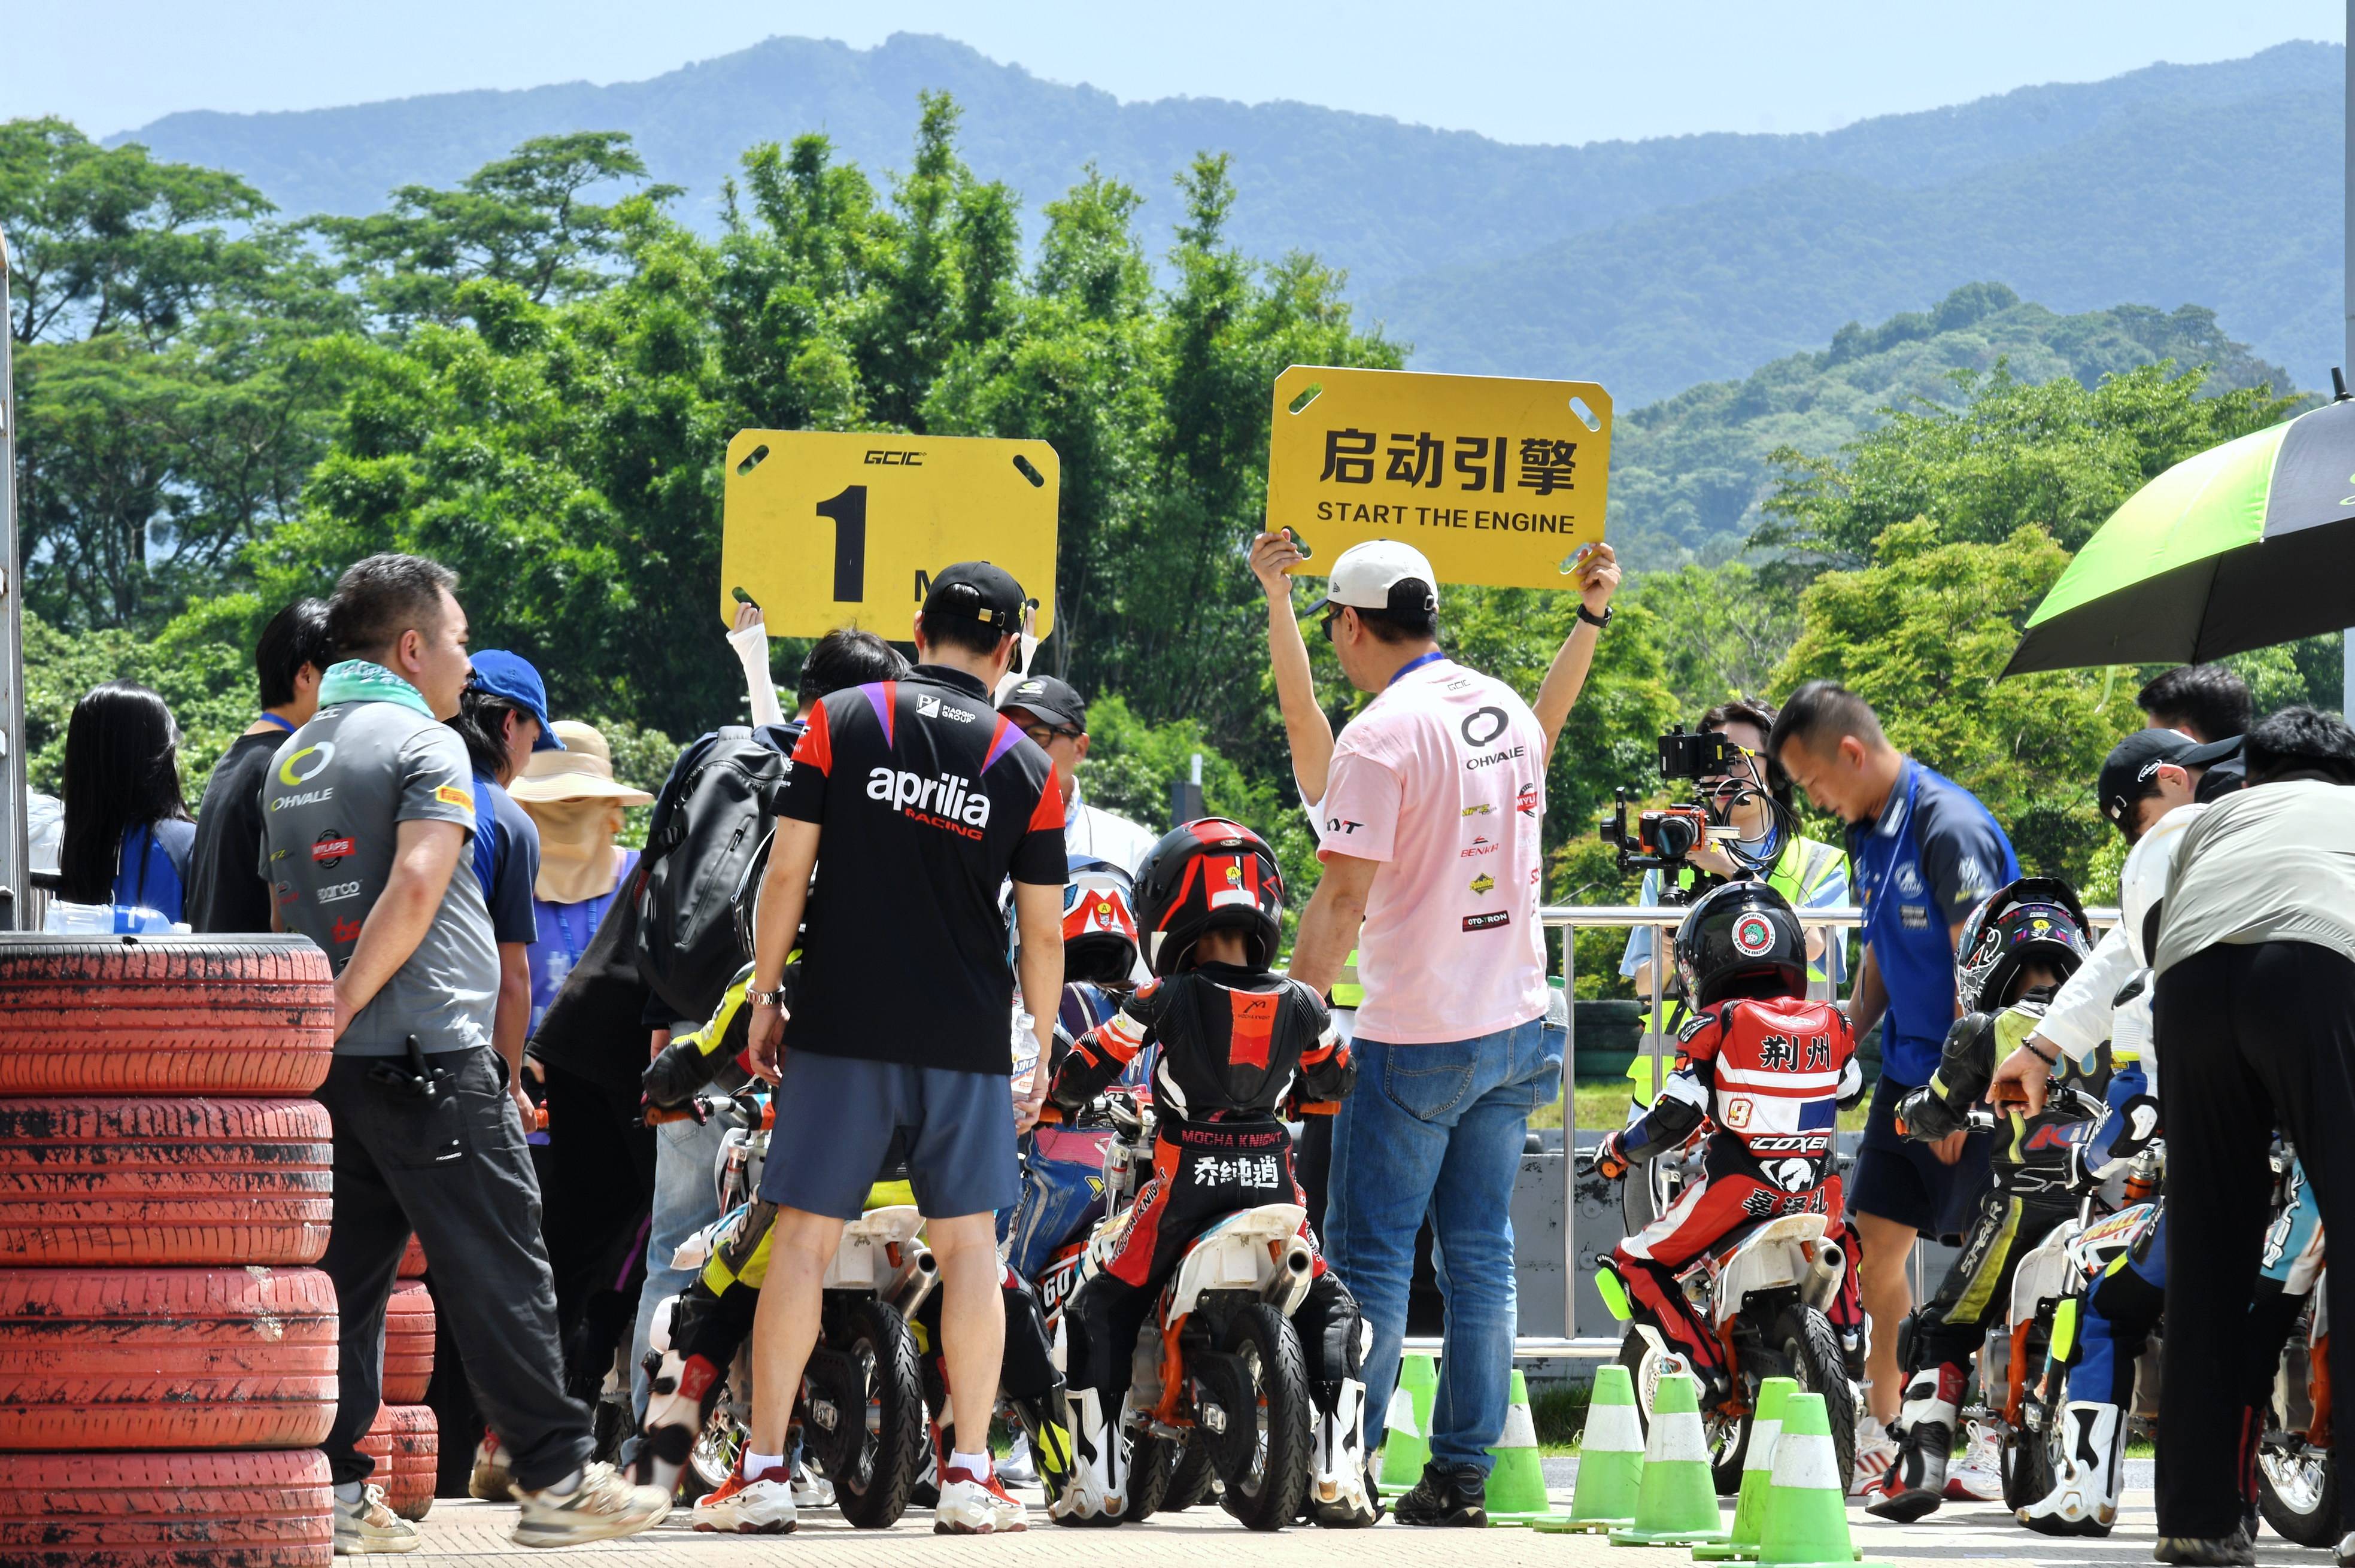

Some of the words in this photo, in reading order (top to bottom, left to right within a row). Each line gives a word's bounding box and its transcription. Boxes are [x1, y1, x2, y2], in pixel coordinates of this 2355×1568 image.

[864, 450, 924, 466] GCIC
[1320, 427, 1577, 496] 启动引擎
[1317, 501, 1409, 524] START
[1415, 506, 1468, 528] THE
[1474, 510, 1575, 534] ENGINE
[816, 485, 867, 603] 1
[942, 711, 972, 724] GROUP
[943, 704, 976, 720] PIAGGIO
[1466, 746, 1525, 770] OHVALE
[271, 786, 334, 812] OHVALE
[866, 767, 991, 829] aprilia
[905, 808, 984, 841] RACING
[1758, 1032, 1831, 1072] 荆州
[1182, 1129, 1234, 1147] MOCHA
[1239, 1131, 1282, 1148] KNIGHT
[1043, 1266, 1070, 1308] 60
